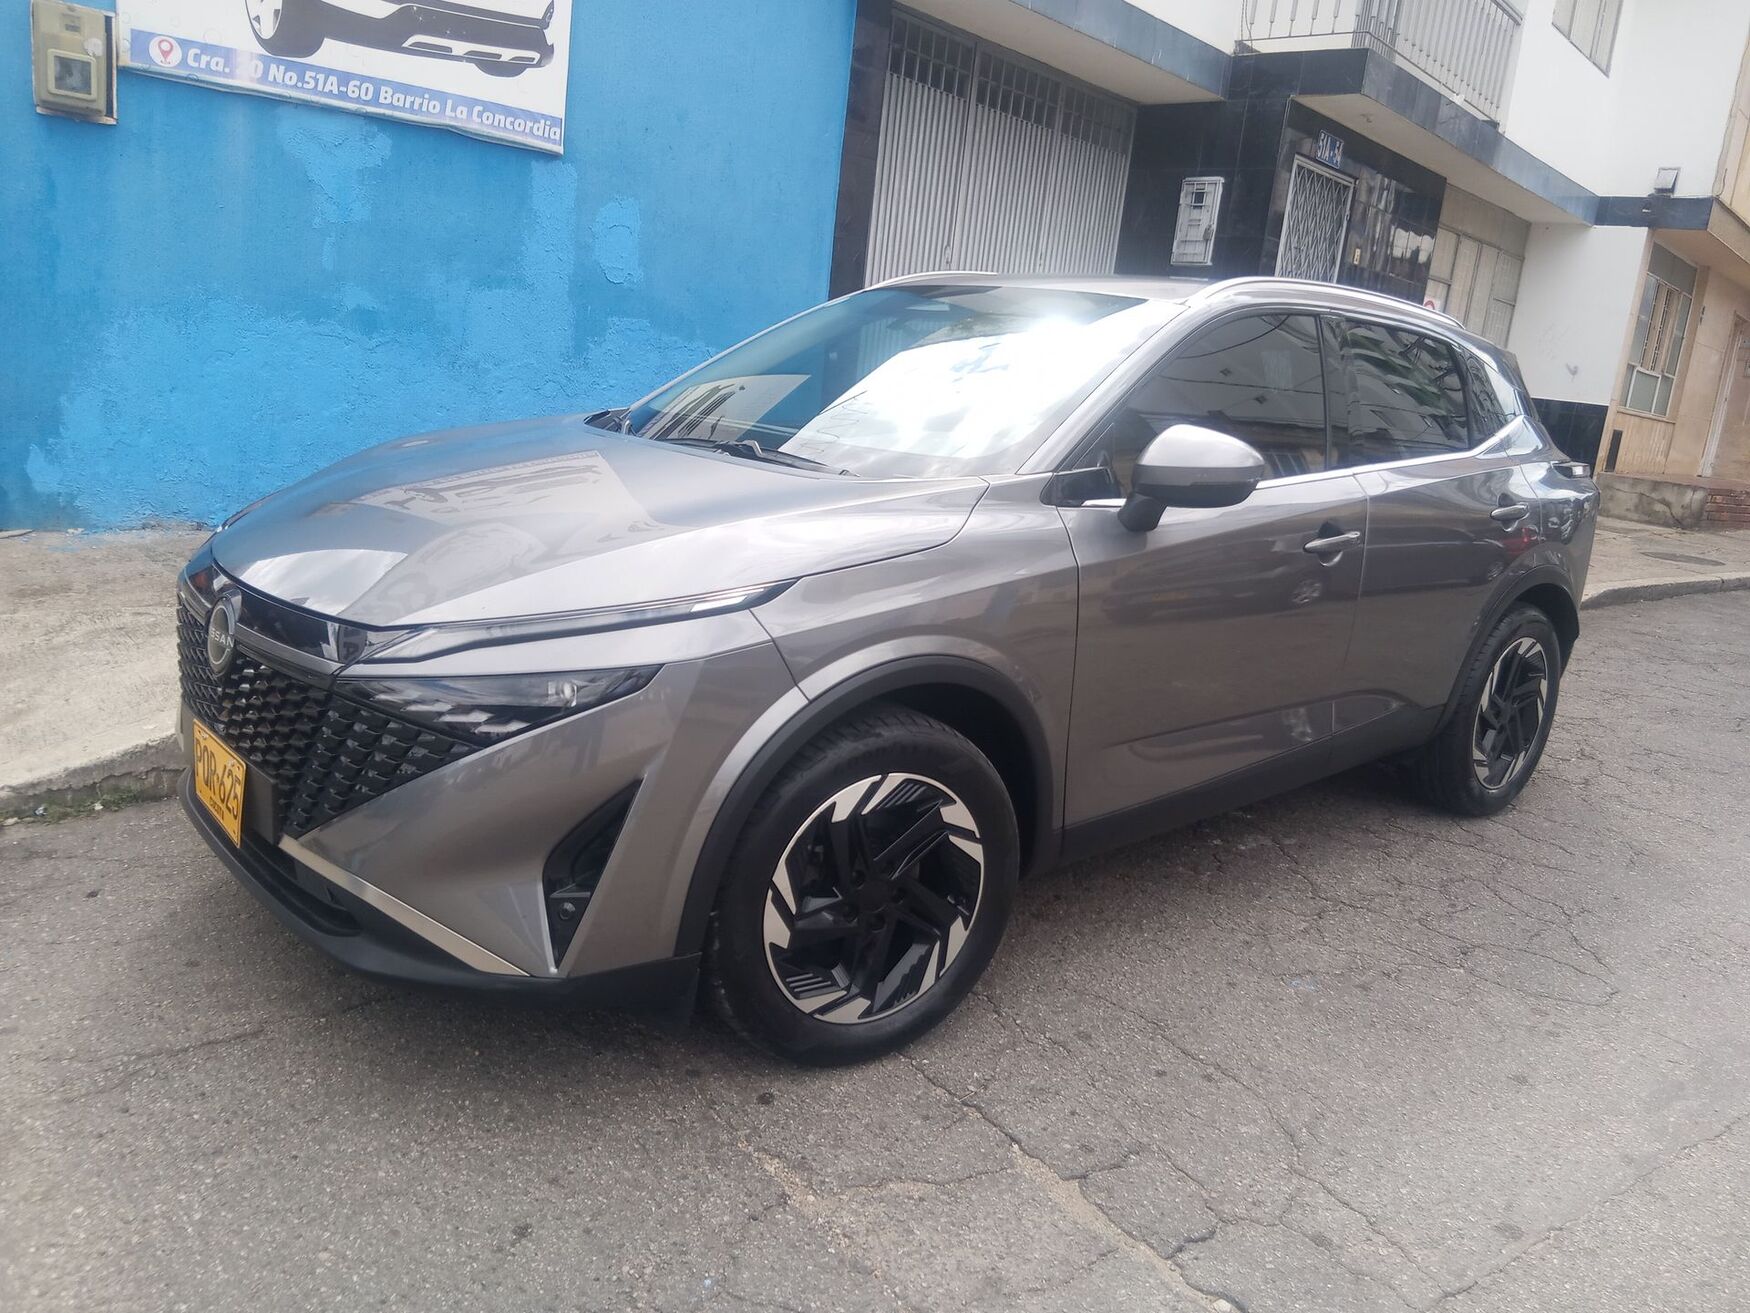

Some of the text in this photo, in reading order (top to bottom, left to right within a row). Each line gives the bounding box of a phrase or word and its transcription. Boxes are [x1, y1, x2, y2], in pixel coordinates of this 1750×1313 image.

[186, 48, 561, 140] Cra. 0 No.51A-60 Barrio La Concordia
